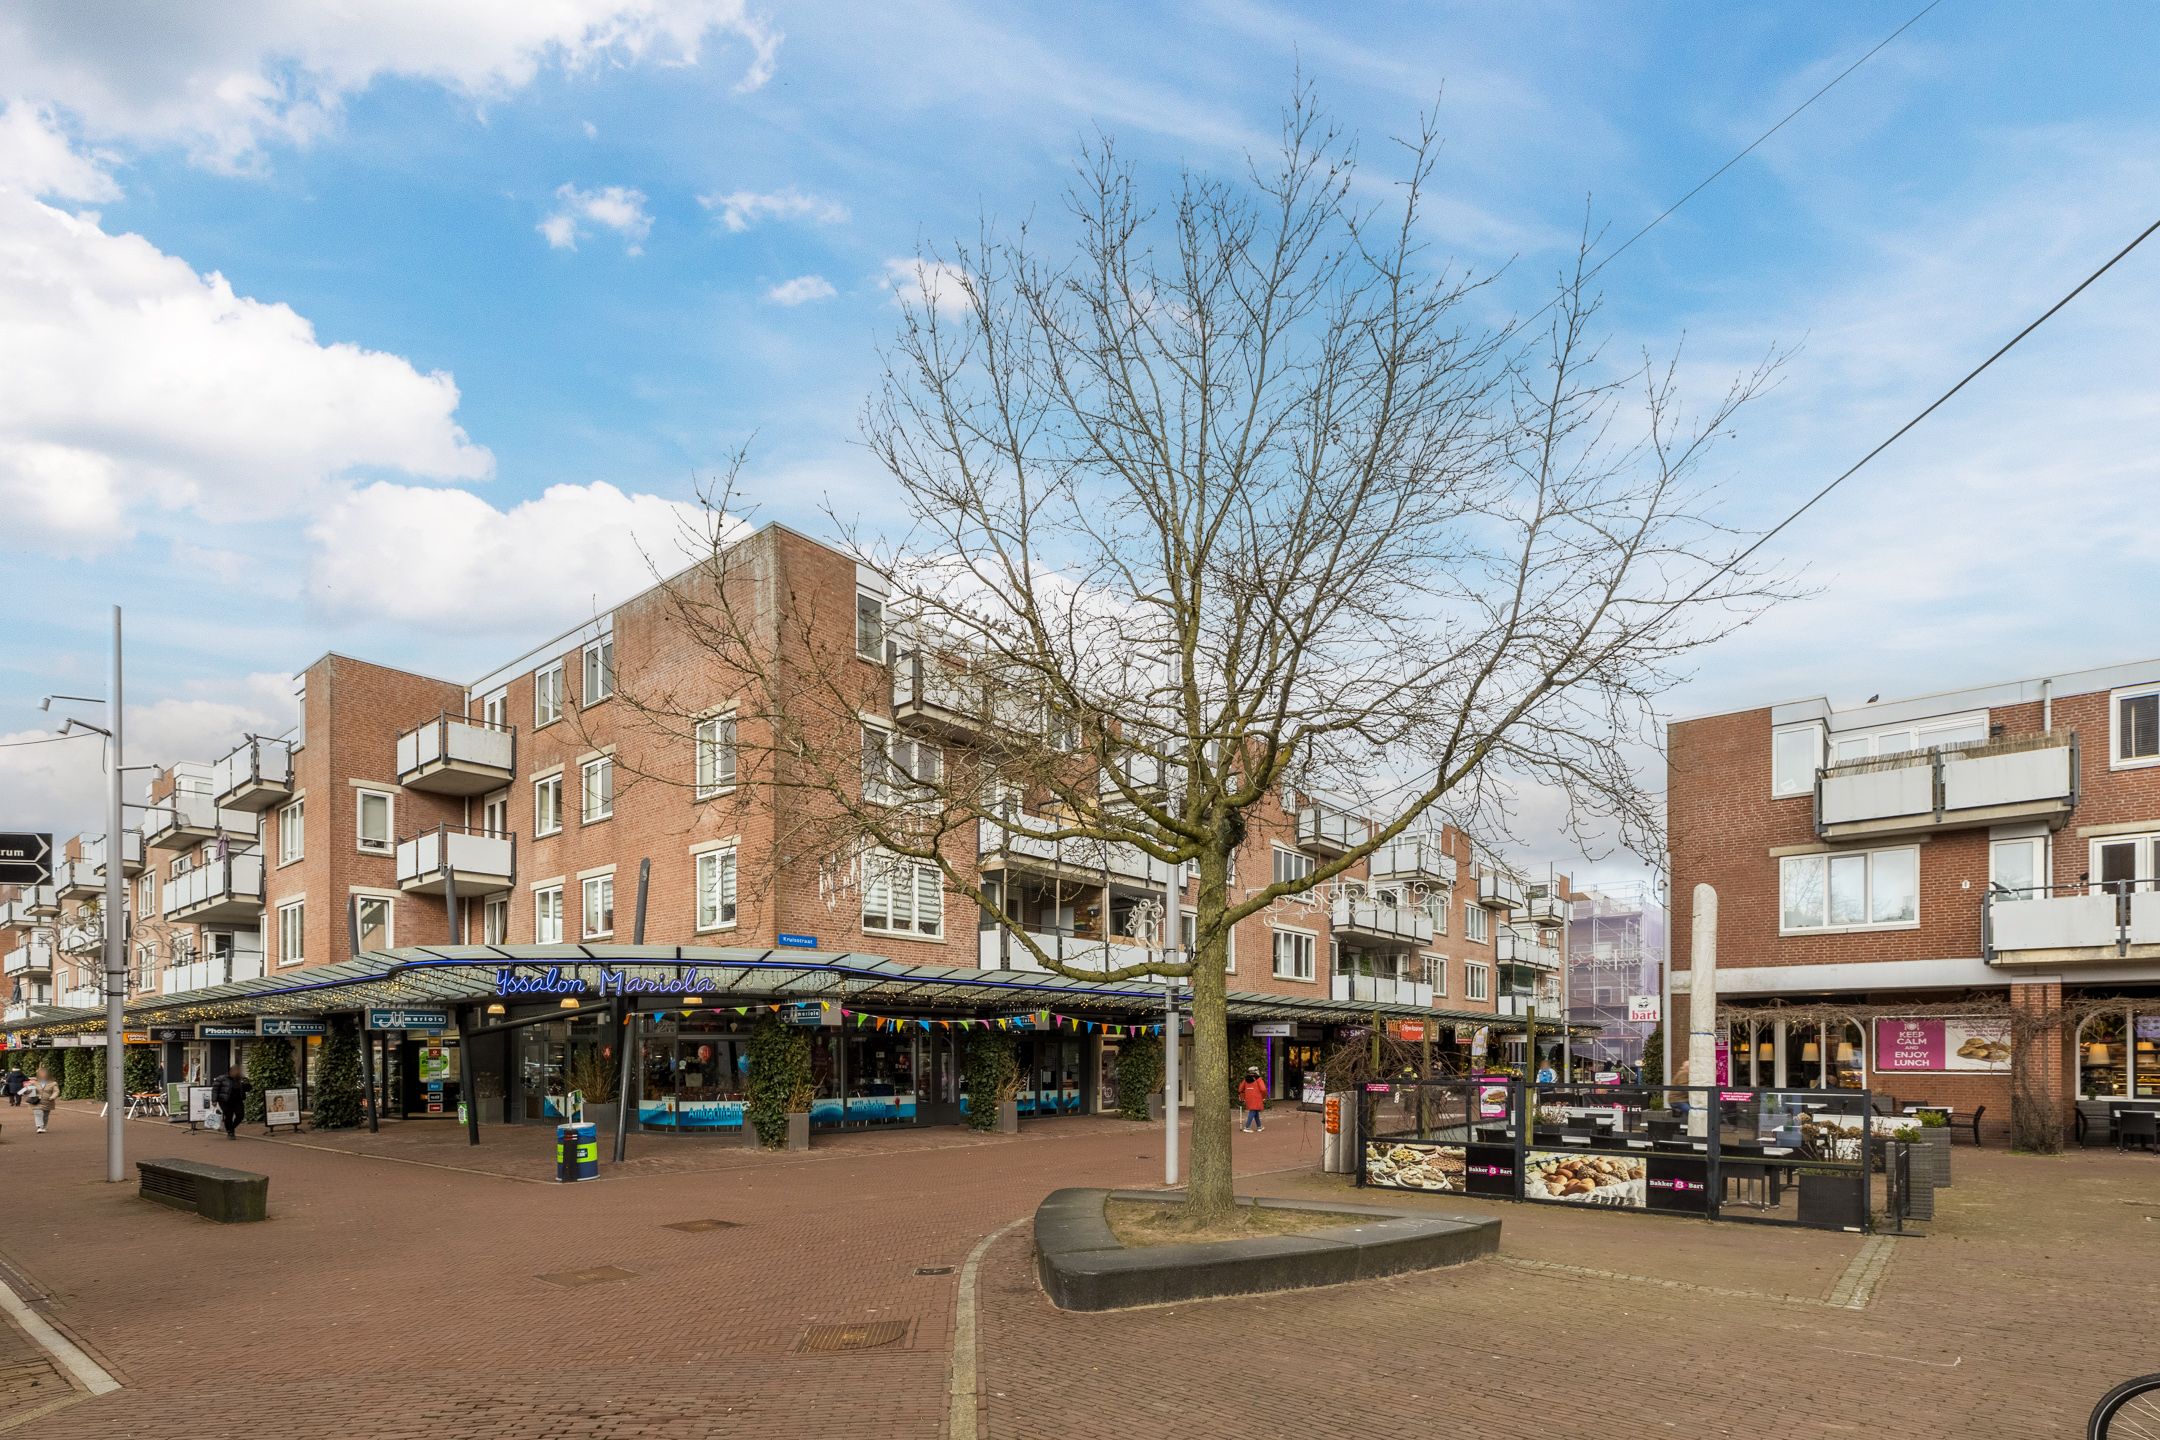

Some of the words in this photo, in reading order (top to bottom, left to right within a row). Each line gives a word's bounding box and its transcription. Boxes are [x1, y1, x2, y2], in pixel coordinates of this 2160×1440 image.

[0, 849, 24, 857] rum
[599, 967, 716, 997] Mariola
[1632, 1009, 1657, 1020] bart
[205, 1027, 232, 1035] Phone
[234, 1027, 256, 1035] Hous
[1894, 1059, 1930, 1067] LUNCH
[1688, 1182, 1704, 1190] Bart
